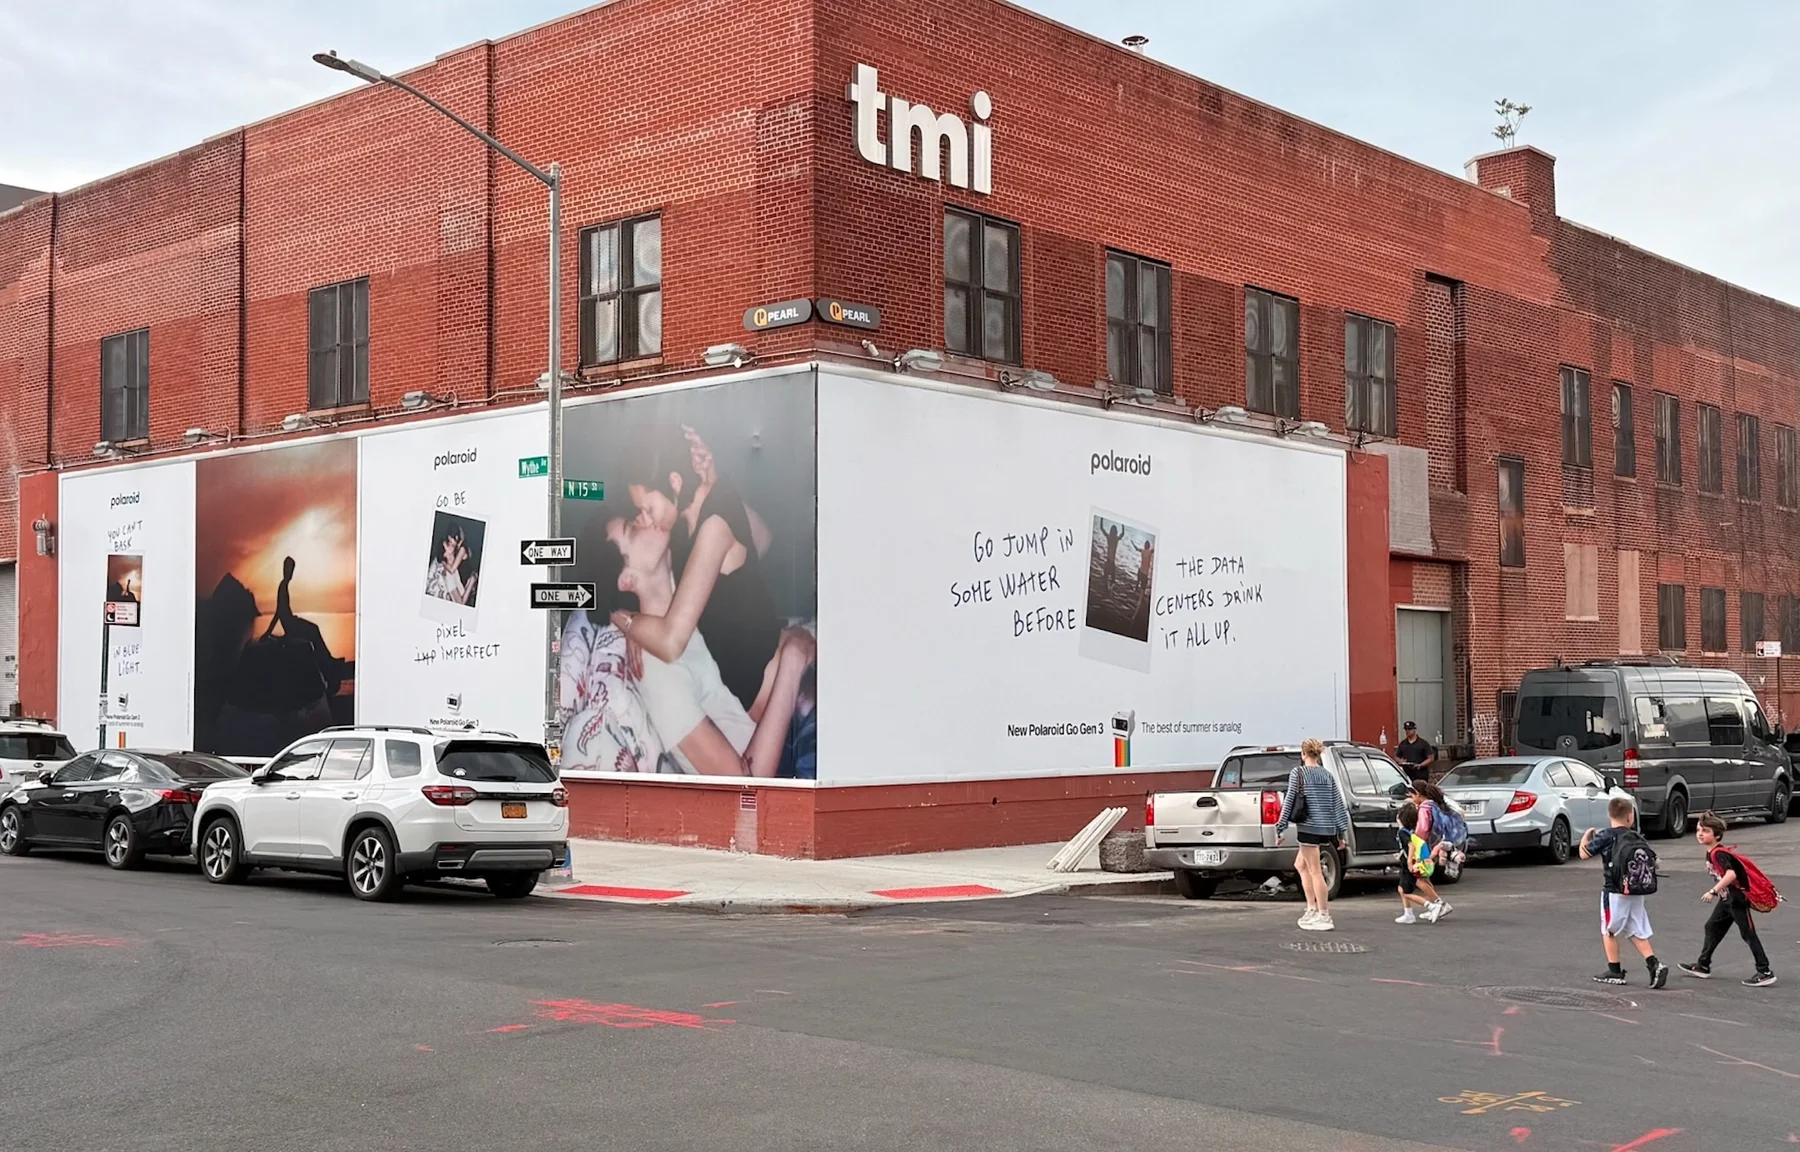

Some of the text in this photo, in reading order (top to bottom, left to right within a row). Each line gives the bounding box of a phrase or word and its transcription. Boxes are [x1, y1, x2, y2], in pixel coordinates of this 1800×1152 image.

[846, 62, 992, 195] tmi
[767, 307, 799, 322] PEARL
[842, 309, 871, 323] PEARL
[433, 447, 477, 471] polaroid
[521, 460, 539, 476] Wythe
[1091, 449, 1151, 476] polaroid
[568, 481, 575, 497] N
[578, 482, 588, 497] 15
[110, 491, 140, 510] polaroid
[436, 490, 467, 508] GO BE
[107, 527, 120, 543] YOU
[114, 536, 133, 552] BASK
[974, 531, 994, 562] GO
[1003, 526, 1048, 557] JUMP
[528, 547, 567, 558] ONE WAY
[1176, 556, 1245, 578] THE DATA
[951, 565, 1061, 607] SOME WATER
[541, 591, 586, 601] ONE WAY
[1156, 589, 1214, 616] CENTERS
[1013, 606, 1076, 637] BEFORE
[1186, 622, 1211, 649] ALL
[1214, 619, 1236, 645] UP.
[1007, 722, 1104, 737] New Polaroid Go Gen 3
[1141, 720, 1242, 735] The best of summer is analog
